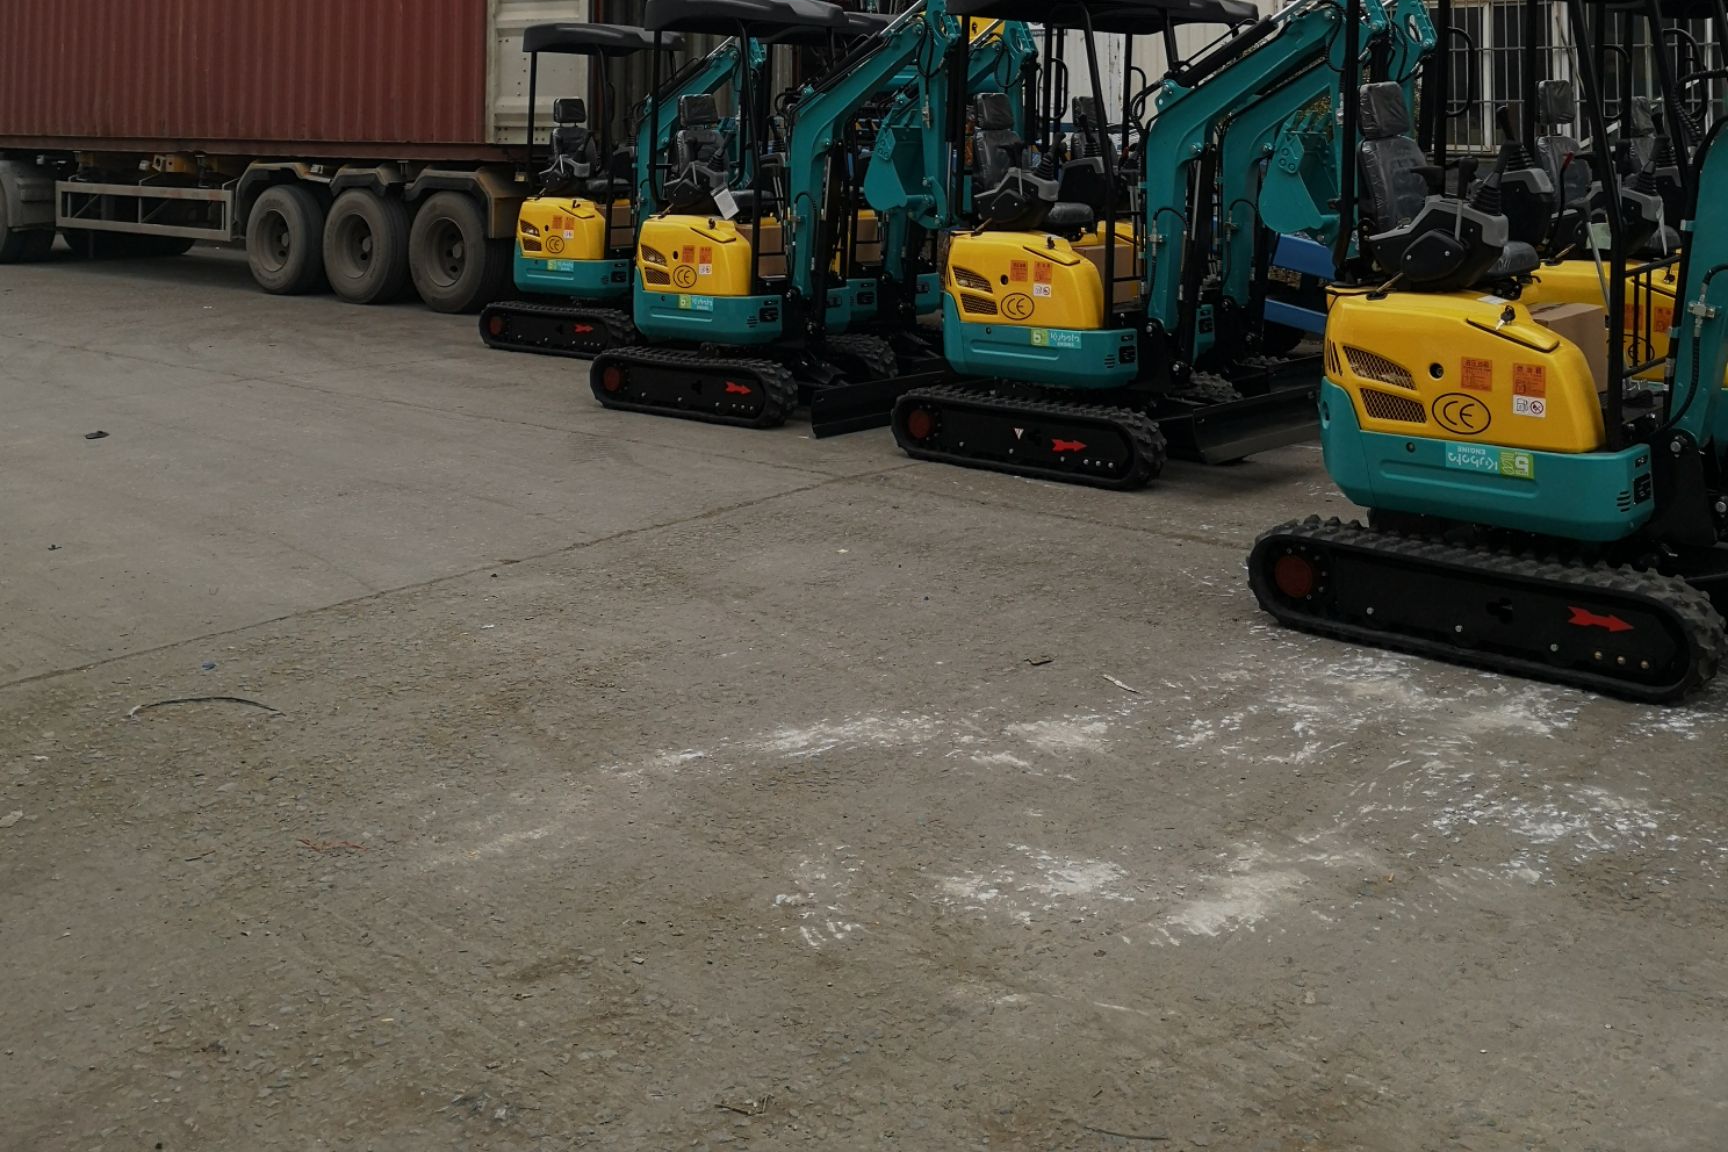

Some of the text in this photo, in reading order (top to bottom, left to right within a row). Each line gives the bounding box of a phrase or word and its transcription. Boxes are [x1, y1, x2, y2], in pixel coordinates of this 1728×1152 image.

[677, 269, 691, 284] CE
[1007, 297, 1026, 315] CE
[1443, 400, 1475, 429] CE
[1456, 445, 1486, 455] ENGINE
[1447, 452, 1498, 470] Kubota
